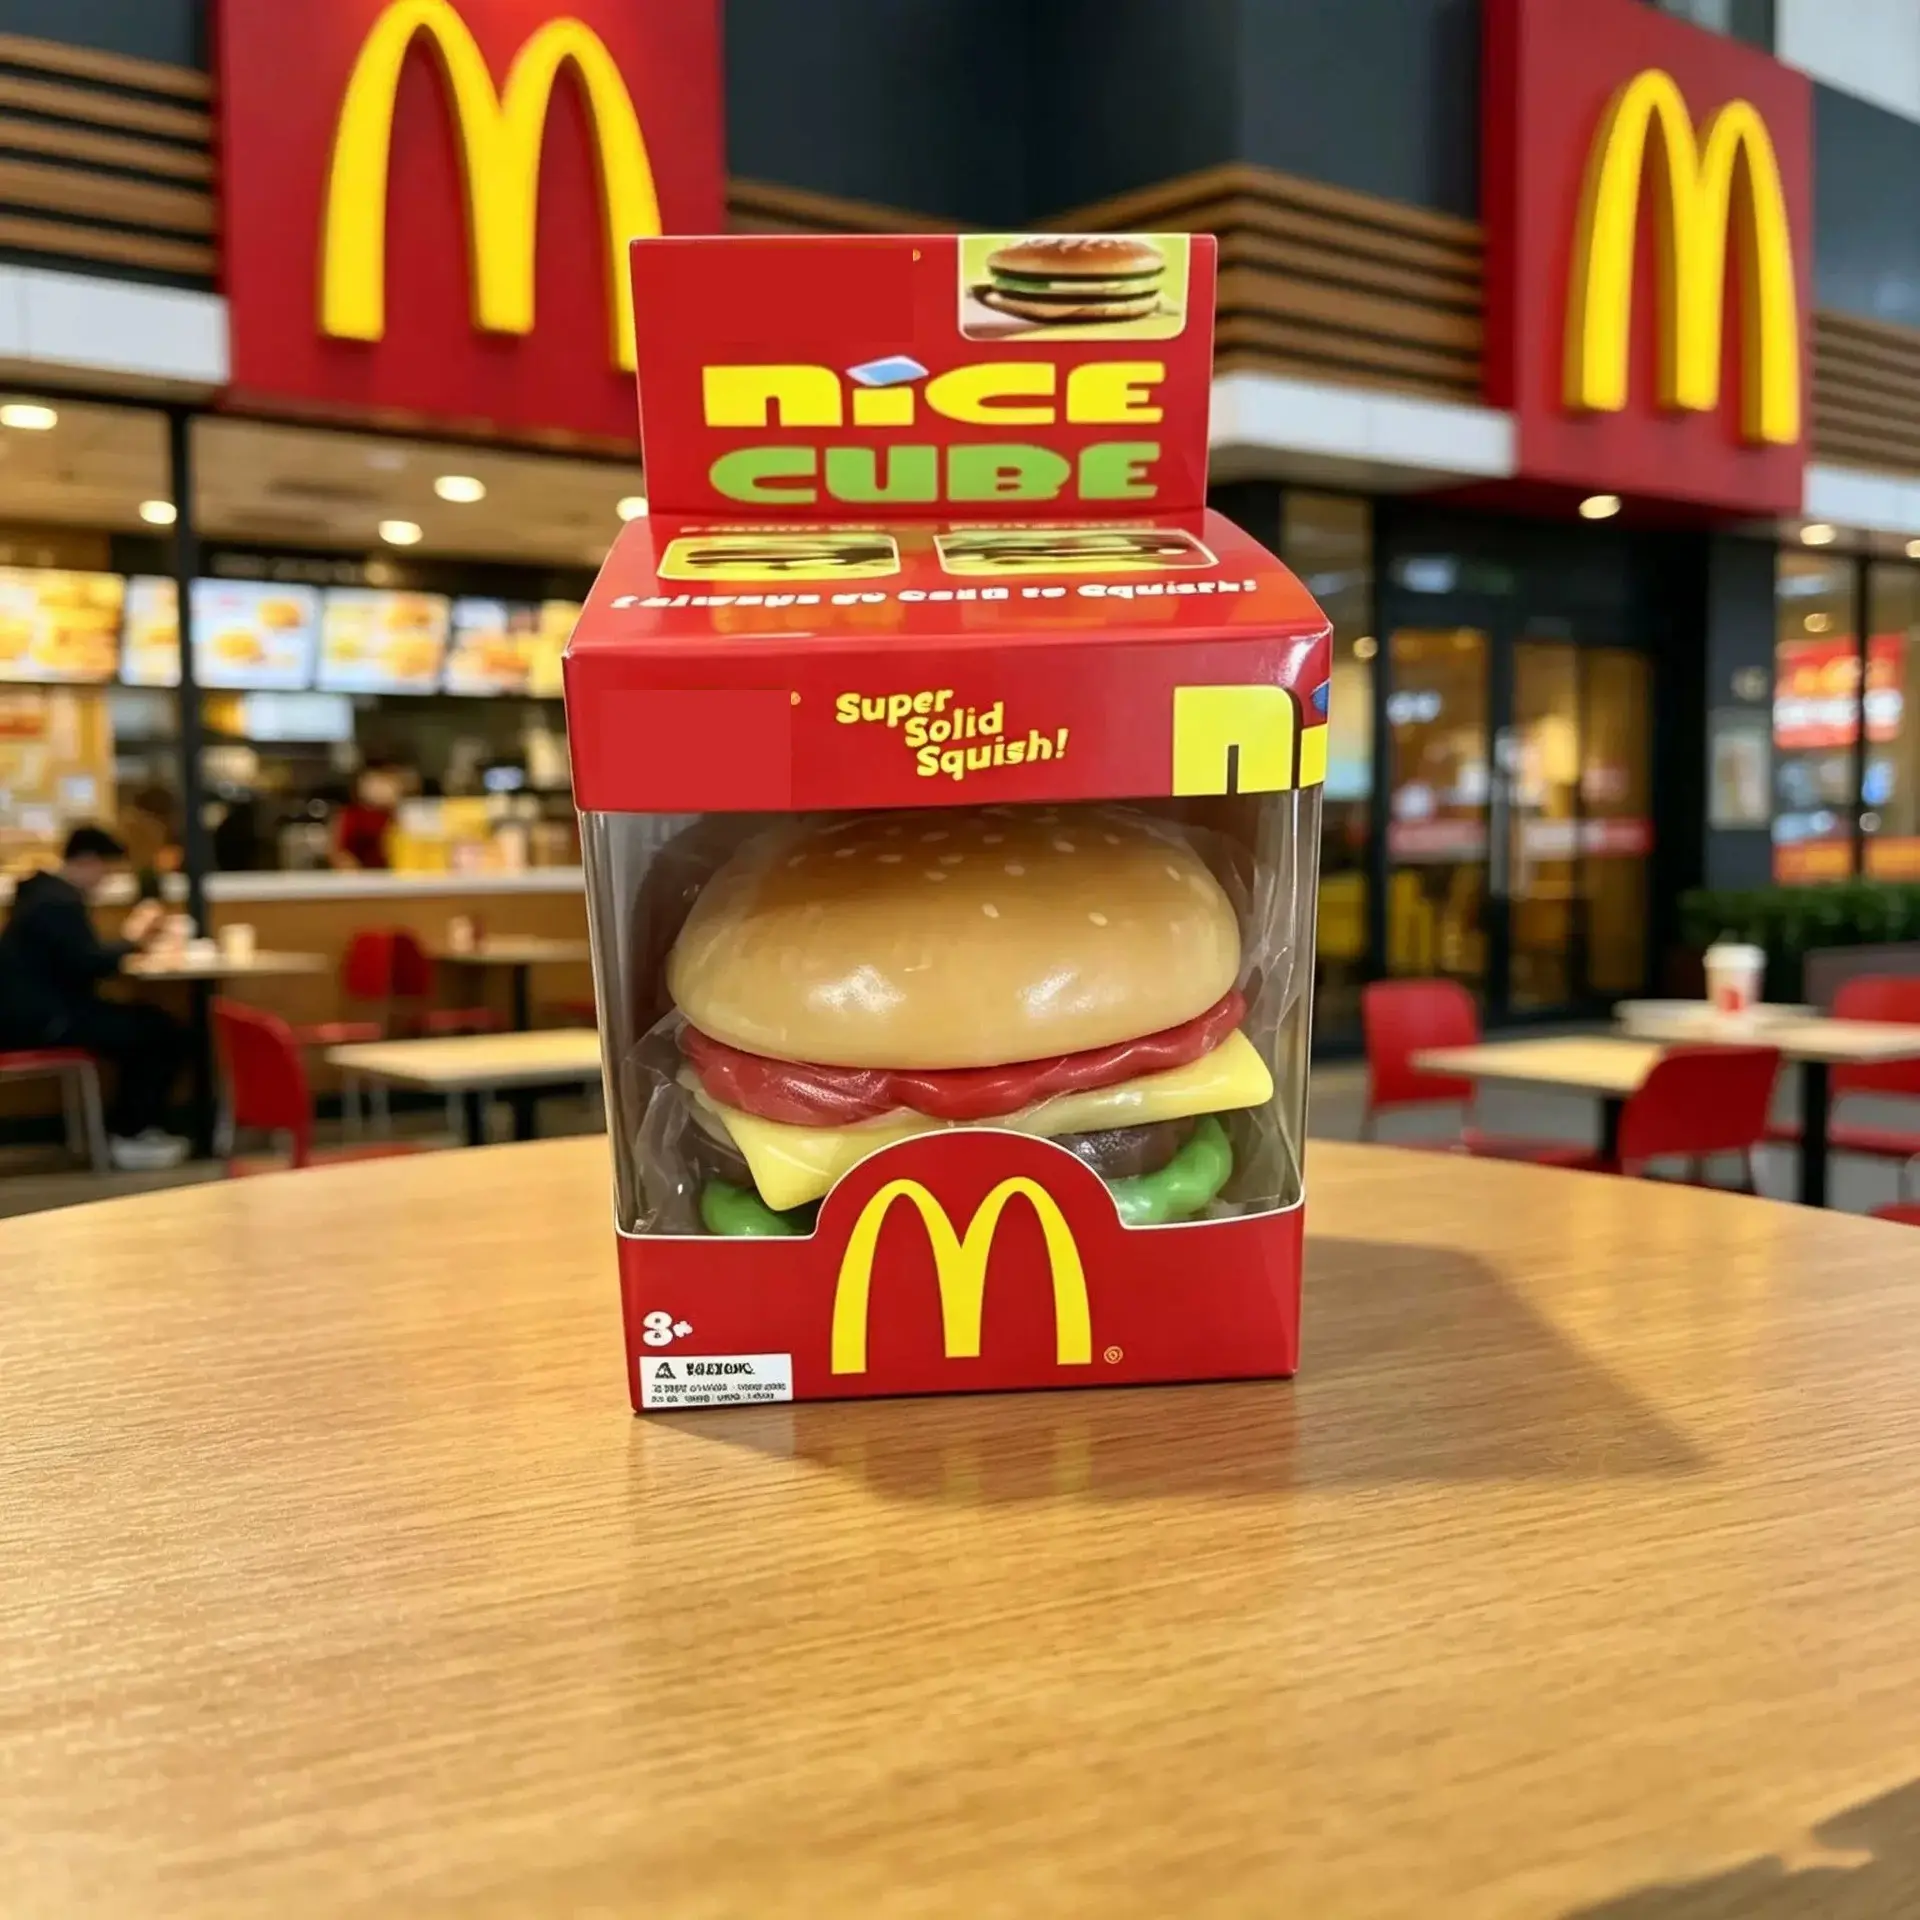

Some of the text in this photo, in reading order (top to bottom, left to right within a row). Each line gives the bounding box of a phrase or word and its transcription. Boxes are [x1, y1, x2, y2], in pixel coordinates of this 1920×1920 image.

[709, 442, 1160, 503] CUBE
[836, 689, 954, 728] Super
[904, 701, 1004, 747] Solid
[916, 728, 1069, 781] Squish!
[831, 1176, 1092, 1374] M
